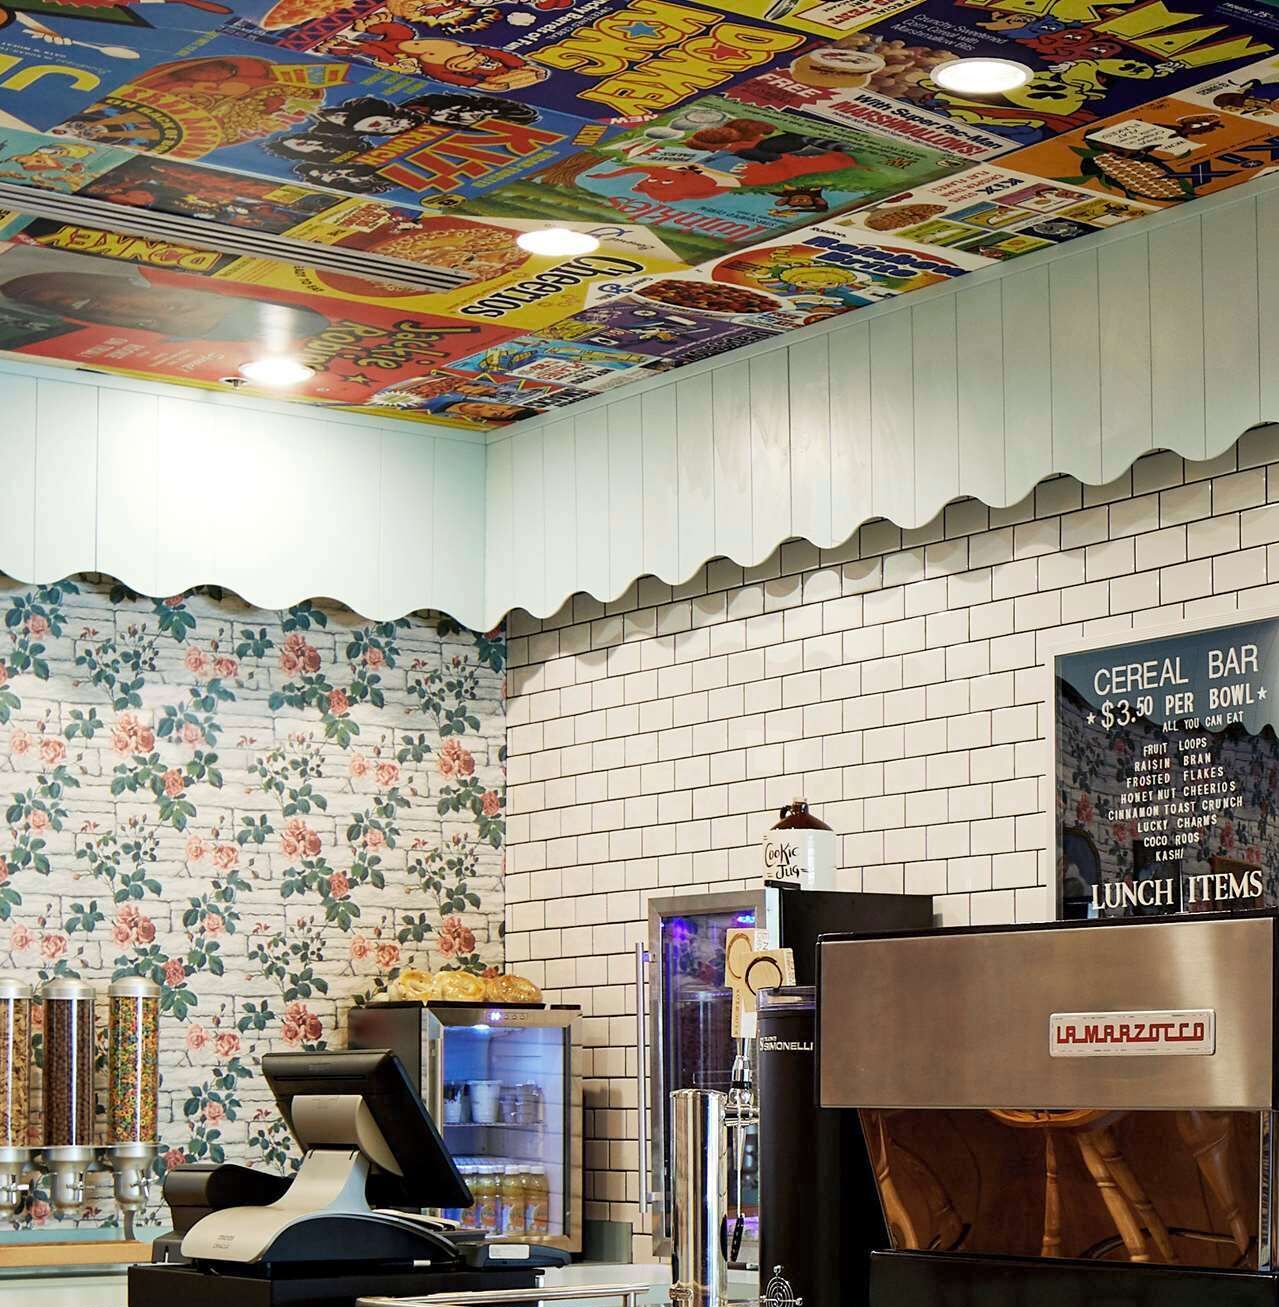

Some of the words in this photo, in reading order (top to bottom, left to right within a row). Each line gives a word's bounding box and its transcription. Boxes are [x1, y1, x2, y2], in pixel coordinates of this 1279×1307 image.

[536, 12, 583, 33] Barrels
[913, 14, 953, 32] Crunchy
[502, 38, 531, 51] Fun
[523, 32, 541, 42] of
[525, 0, 725, 75] KONG
[577, 22, 806, 117] DONKEY
[754, 72, 823, 99] FREE
[609, 113, 658, 125] NEW
[829, 100, 990, 157] MARSHMALLOWS!
[854, 94, 890, 111] With
[891, 106, 942, 128] Super
[937, 121, 1002, 150] Pac-Man
[358, 126, 445, 166] KRUNCH
[572, 124, 608, 147] NEW!
[378, 118, 567, 193] KISS
[604, 196, 766, 243] Twinkles
[814, 251, 920, 279] Brite
[459, 255, 645, 319] Cheerios
[1094, 656, 1189, 696] CEREAL
[1208, 644, 1259, 679] BAR
[1101, 696, 1154, 731] $3.50
[1165, 692, 1194, 716] PER
[1209, 683, 1255, 710] BOWL
[1162, 722, 1179, 733] ALL
[1184, 718, 1200, 730] YOU
[1205, 714, 1223, 727] CAN
[1227, 711, 1244, 724] EAT
[1143, 743, 1168, 757] FRUIT
[1179, 737, 1208, 751] LOOPS
[1134, 757, 1170, 772] RAISIN
[1183, 752, 1211, 766] BRAN
[1126, 773, 1170, 788] FROSTED
[1183, 766, 1224, 781] FLAKES
[1121, 790, 1154, 805] HONEY
[1158, 788, 1177, 801] NUT
[1183, 780, 1236, 797] CHEERIOS
[1108, 804, 1159, 821] CINNAMON
[1164, 801, 1196, 815] TOAST
[1202, 796, 1243, 811] CRUNCH
[1137, 819, 1169, 833] LUCKY
[1177, 814, 1218, 829] CHARMS
[1144, 835, 1168, 847] COCO
[1175, 832, 1200, 846] ROOS
[1091, 877, 1174, 910] LUNCH
[1188, 870, 1264, 904] ITEMS
